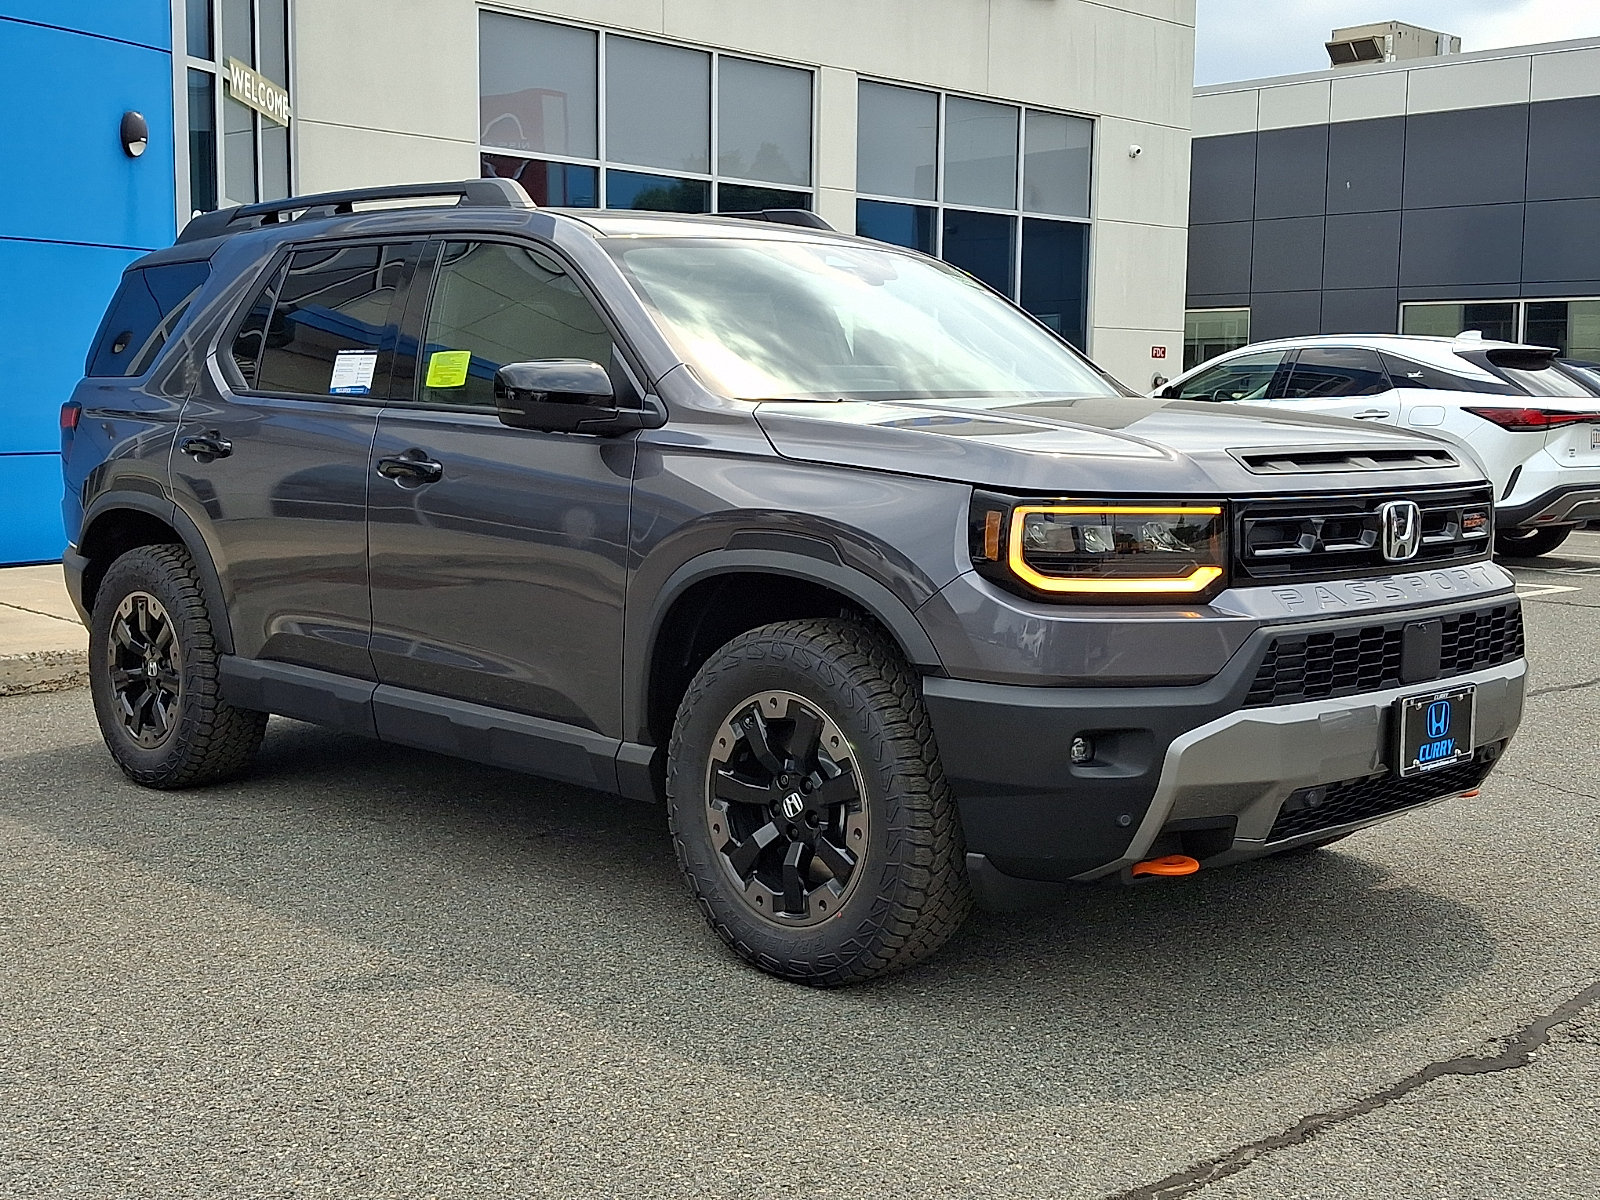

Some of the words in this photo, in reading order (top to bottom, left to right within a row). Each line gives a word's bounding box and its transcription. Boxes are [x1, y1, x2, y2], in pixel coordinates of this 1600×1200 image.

[230, 63, 288, 121] WELCOME
[1153, 347, 1165, 358] FDC
[1271, 566, 1494, 612] PASSPORT
[1419, 738, 1455, 762] CURRY
